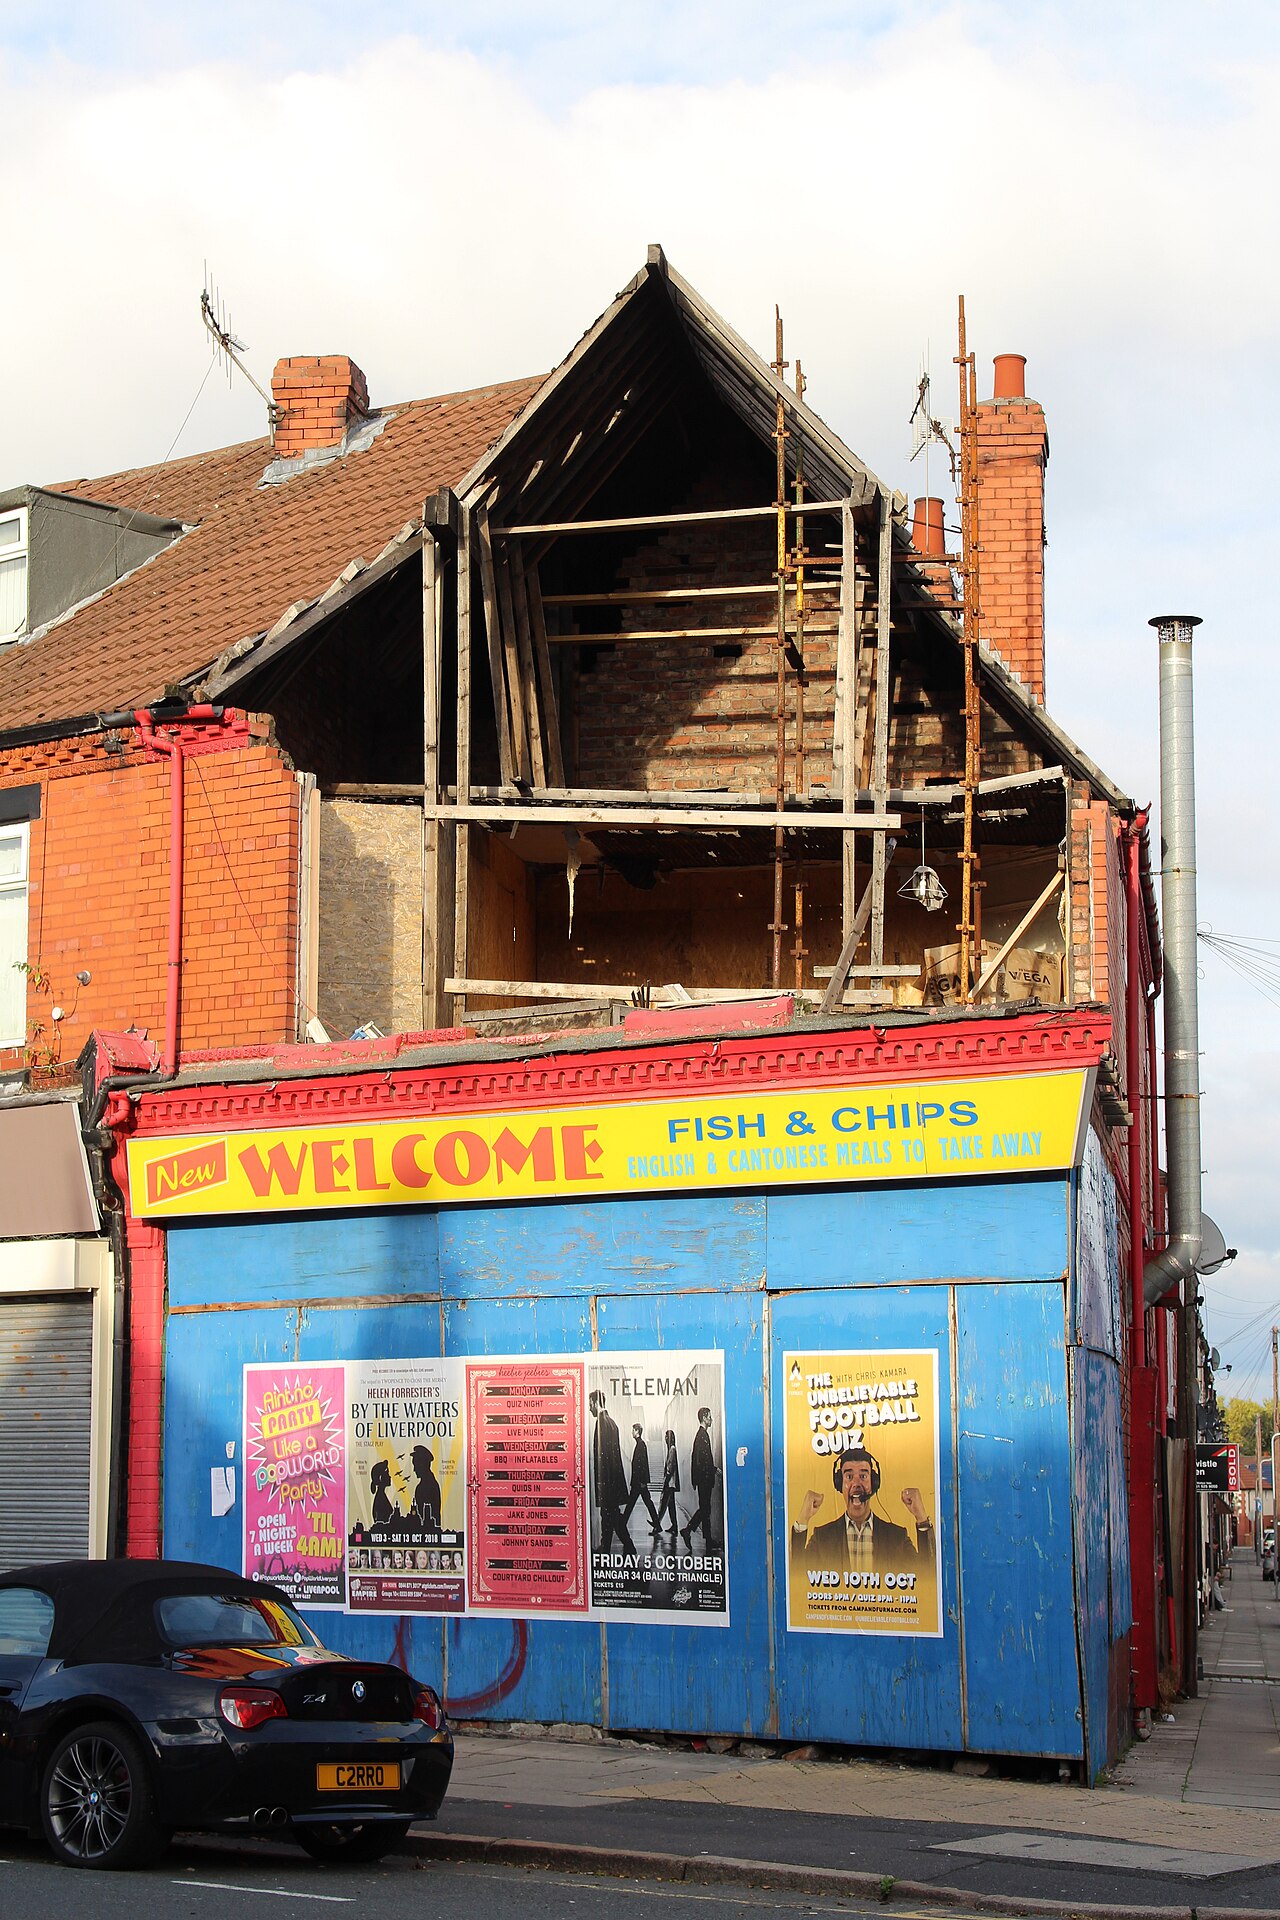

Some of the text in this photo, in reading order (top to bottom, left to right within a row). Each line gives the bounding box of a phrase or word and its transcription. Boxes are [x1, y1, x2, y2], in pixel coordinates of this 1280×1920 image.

[667, 1100, 979, 1144] FISH & CHIPS
[155, 1123, 605, 1198] New WELCOME
[628, 1130, 1043, 1179] ENGLISH & CANTONESE MEALS TO TAKE AWAY
[806, 1372, 832, 1389] THE
[836, 1367, 907, 1384] WITH CHRIS KAMARA
[294, 1384, 313, 1402] no
[367, 1386, 440, 1399] HELEN FORRESTER'S
[509, 1386, 541, 1395] MONDAY
[609, 1378, 698, 1396] TELEMAN
[807, 1379, 918, 1408] UNBELIEVABLE
[351, 1401, 459, 1419] BY THE WATERS
[506, 1400, 522, 1408] QUIZ
[268, 1405, 314, 1434] PARTY
[508, 1415, 542, 1424] TUESDAY
[809, 1400, 920, 1432] FOOTBALL
[355, 1421, 456, 1438] OF LIVERPOOL
[523, 1428, 544, 1436] MUSIC
[273, 1436, 317, 1458] Like a
[503, 1442, 549, 1451] WEDNESDAY
[811, 1429, 865, 1456] QUIZ
[494, 1455, 558, 1464] BBQ INFLATABLES
[1228, 1448, 1236, 1486] SOLD
[507, 1471, 545, 1480] THURSDAY
[280, 1479, 323, 1504] Party
[512, 1484, 541, 1492] QUIDS IN
[513, 1497, 541, 1506] FRIDAY
[257, 1513, 287, 1529] OPEN
[507, 1511, 548, 1519] JAKE JONES
[306, 1512, 336, 1534] 'TIL
[508, 1525, 546, 1534] SATURDAY
[249, 1530, 256, 1543] 7
[371, 1533, 382, 1543] WED
[383, 1533, 387, 1543] 3
[391, 1533, 401, 1543] SAT
[403, 1533, 410, 1543] 13
[411, 1533, 422, 1543] OCT
[424, 1533, 438, 1543] 2018
[502, 1539, 553, 1547] JOHNNY SANDS
[254, 1539, 294, 1556] A WEEK
[296, 1535, 343, 1559] 4AM!
[512, 1559, 543, 1569] SUNDAY
[592, 1553, 722, 1571] FRIDAY 5 OCTOBER
[492, 1573, 565, 1583] COURTYARD CHILLOUT
[593, 1570, 723, 1585] HANGAR 34 (BALTIC TRIANGLE)
[807, 1570, 917, 1590] WED 10TH OCT
[275, 1585, 340, 1595] REET LIVERPOOL
[807, 1592, 833, 1601] DOORS
[857, 1593, 877, 1602] QUIZ
[899, 1595, 918, 1604] 11PM
[848, 1605, 917, 1613] CAMPANDFURNACE.COM
[303, 1693, 327, 1704] Z4
